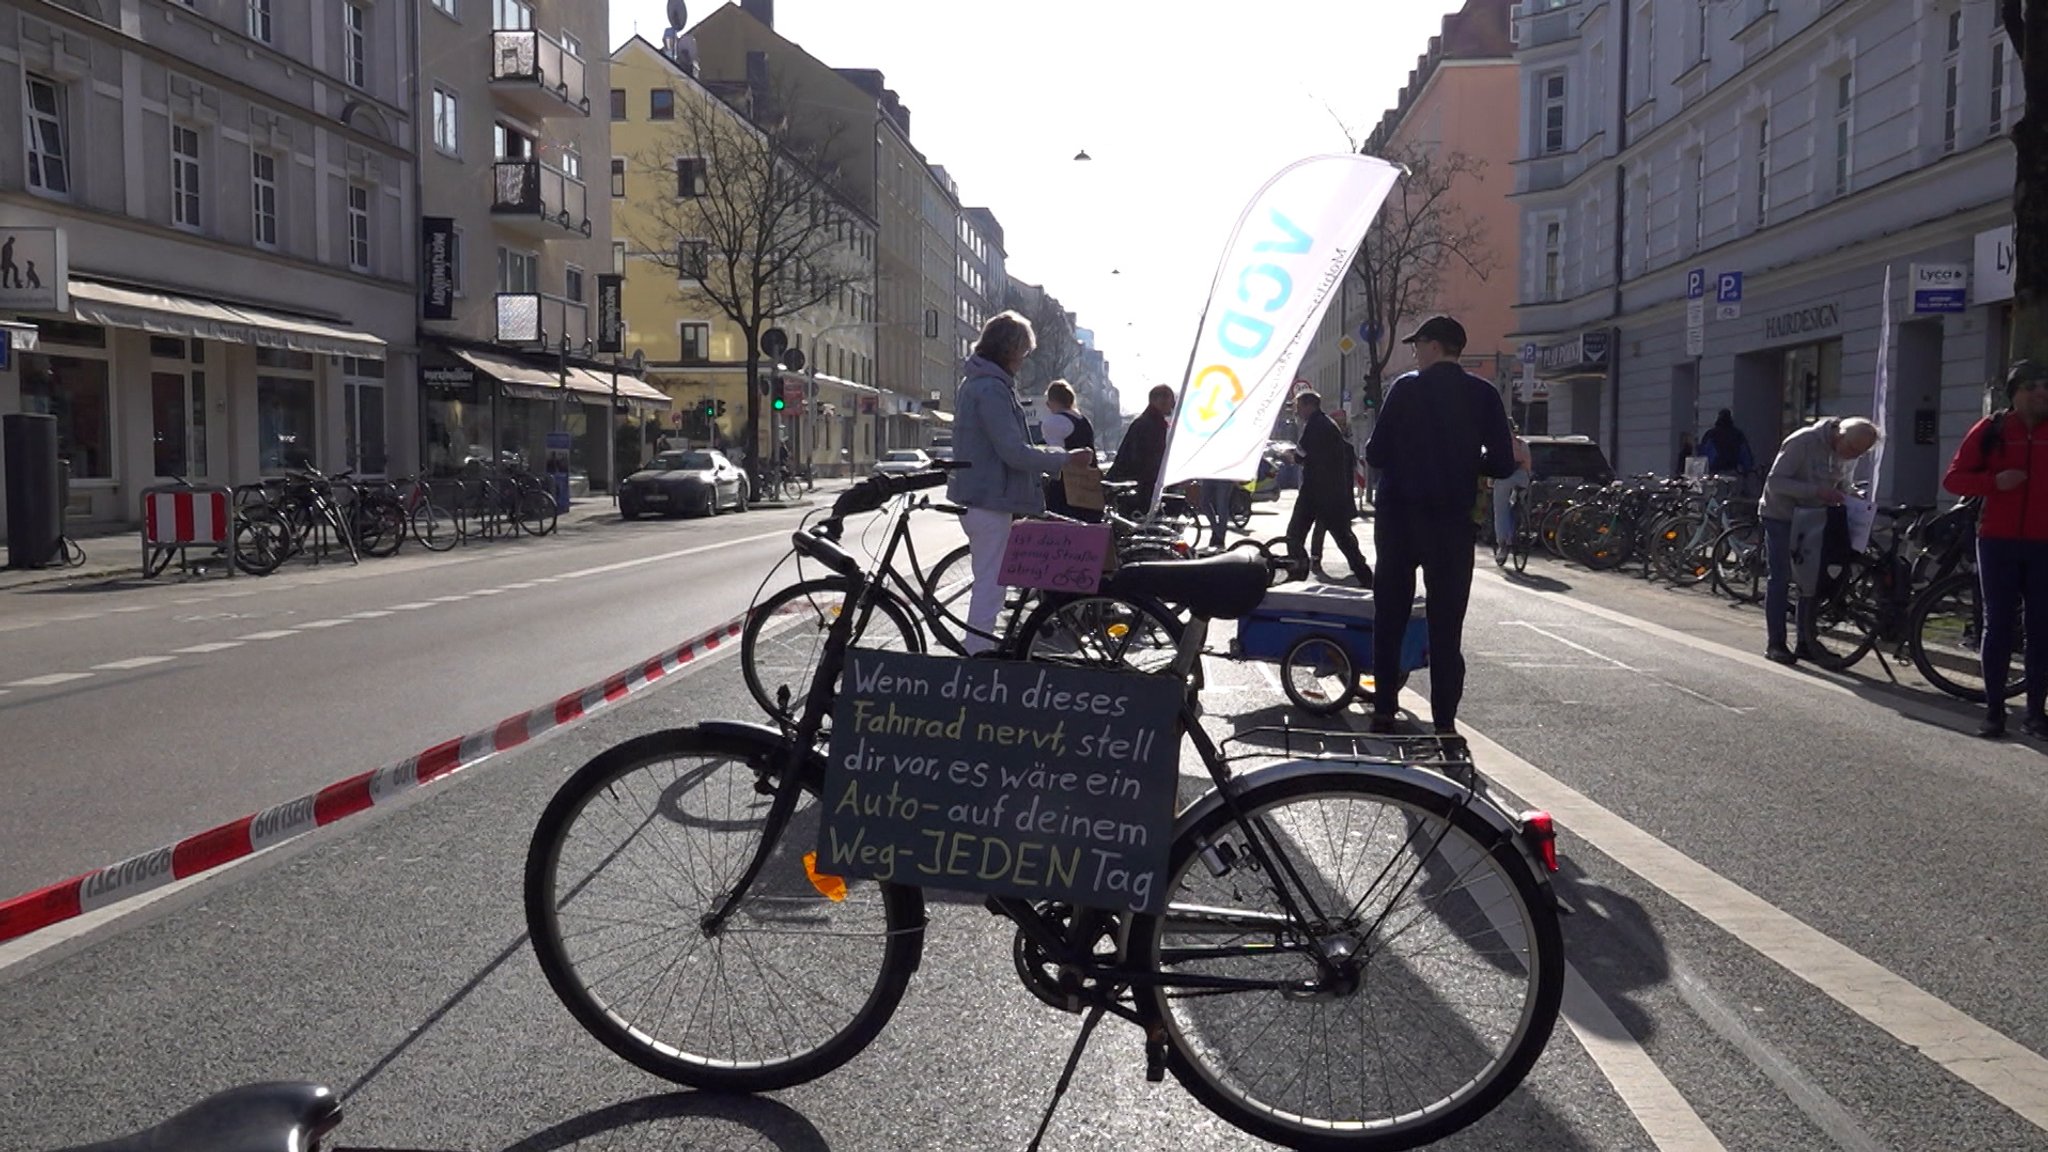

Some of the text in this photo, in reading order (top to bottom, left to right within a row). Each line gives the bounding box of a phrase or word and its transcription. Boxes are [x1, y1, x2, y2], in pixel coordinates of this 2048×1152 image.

[1720, 276, 1735, 299] P
[1766, 302, 1839, 339] HAIRDESIGN
[854, 659, 1128, 717] Wenn dich dieses
[852, 700, 1156, 761] Fahrrad nervt, stell
[844, 738, 1141, 799] dir vor, es wäre ein
[947, 794, 1009, 831] auf
[1015, 796, 1147, 846] deinem
[1091, 848, 1153, 911] Tag
